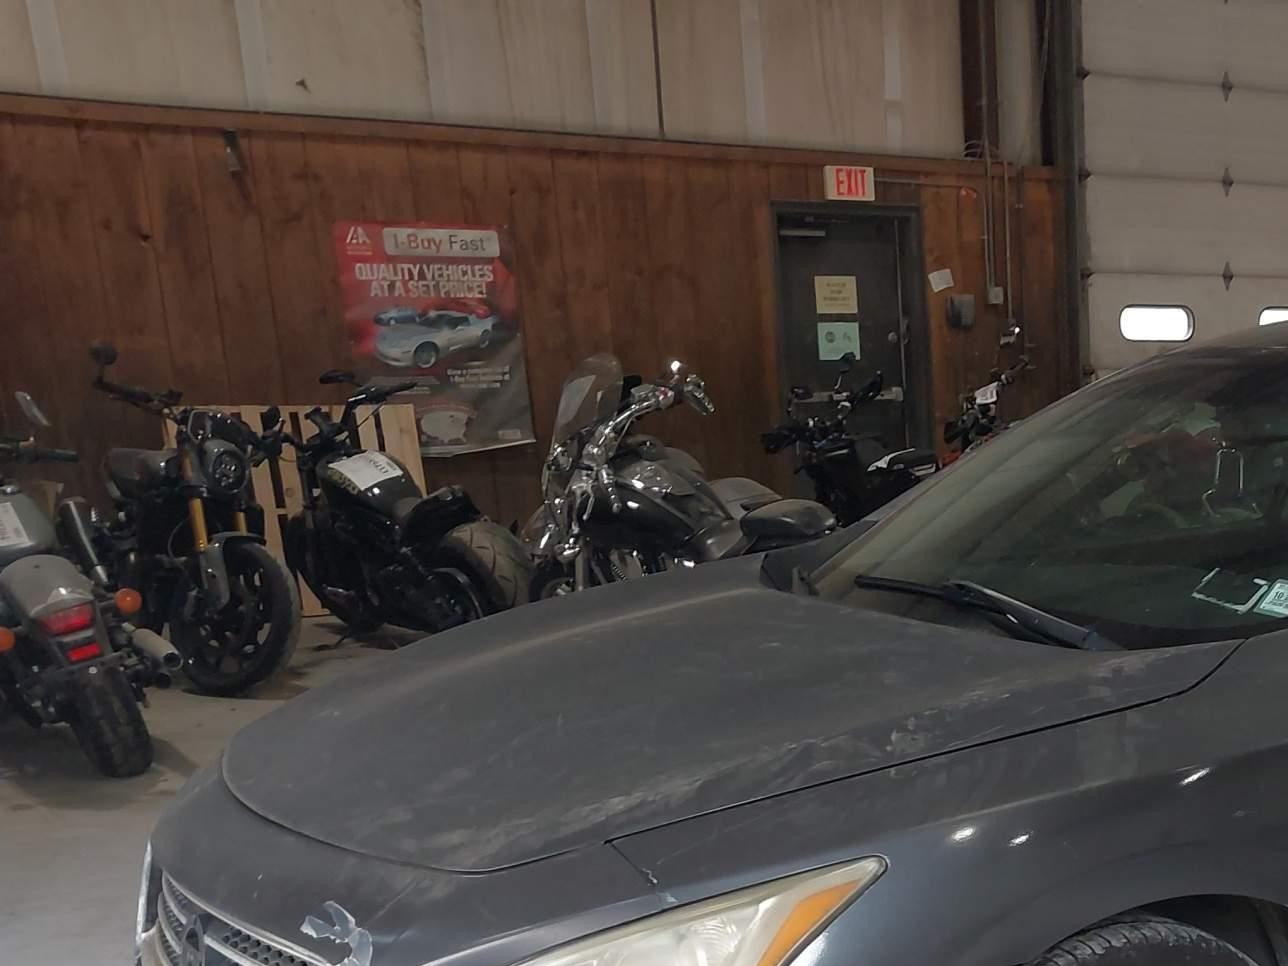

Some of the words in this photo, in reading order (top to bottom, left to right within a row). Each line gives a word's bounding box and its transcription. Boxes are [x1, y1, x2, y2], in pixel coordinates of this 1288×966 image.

[834, 168, 866, 197] EXIT
[393, 233, 442, 254] I-Buy
[355, 263, 420, 281] QUALITY
[422, 264, 494, 282] VEHICLES
[370, 281, 391, 298] AT
[391, 282, 406, 298] A
[407, 282, 438, 298] SET
[439, 282, 488, 299] PRICE!
